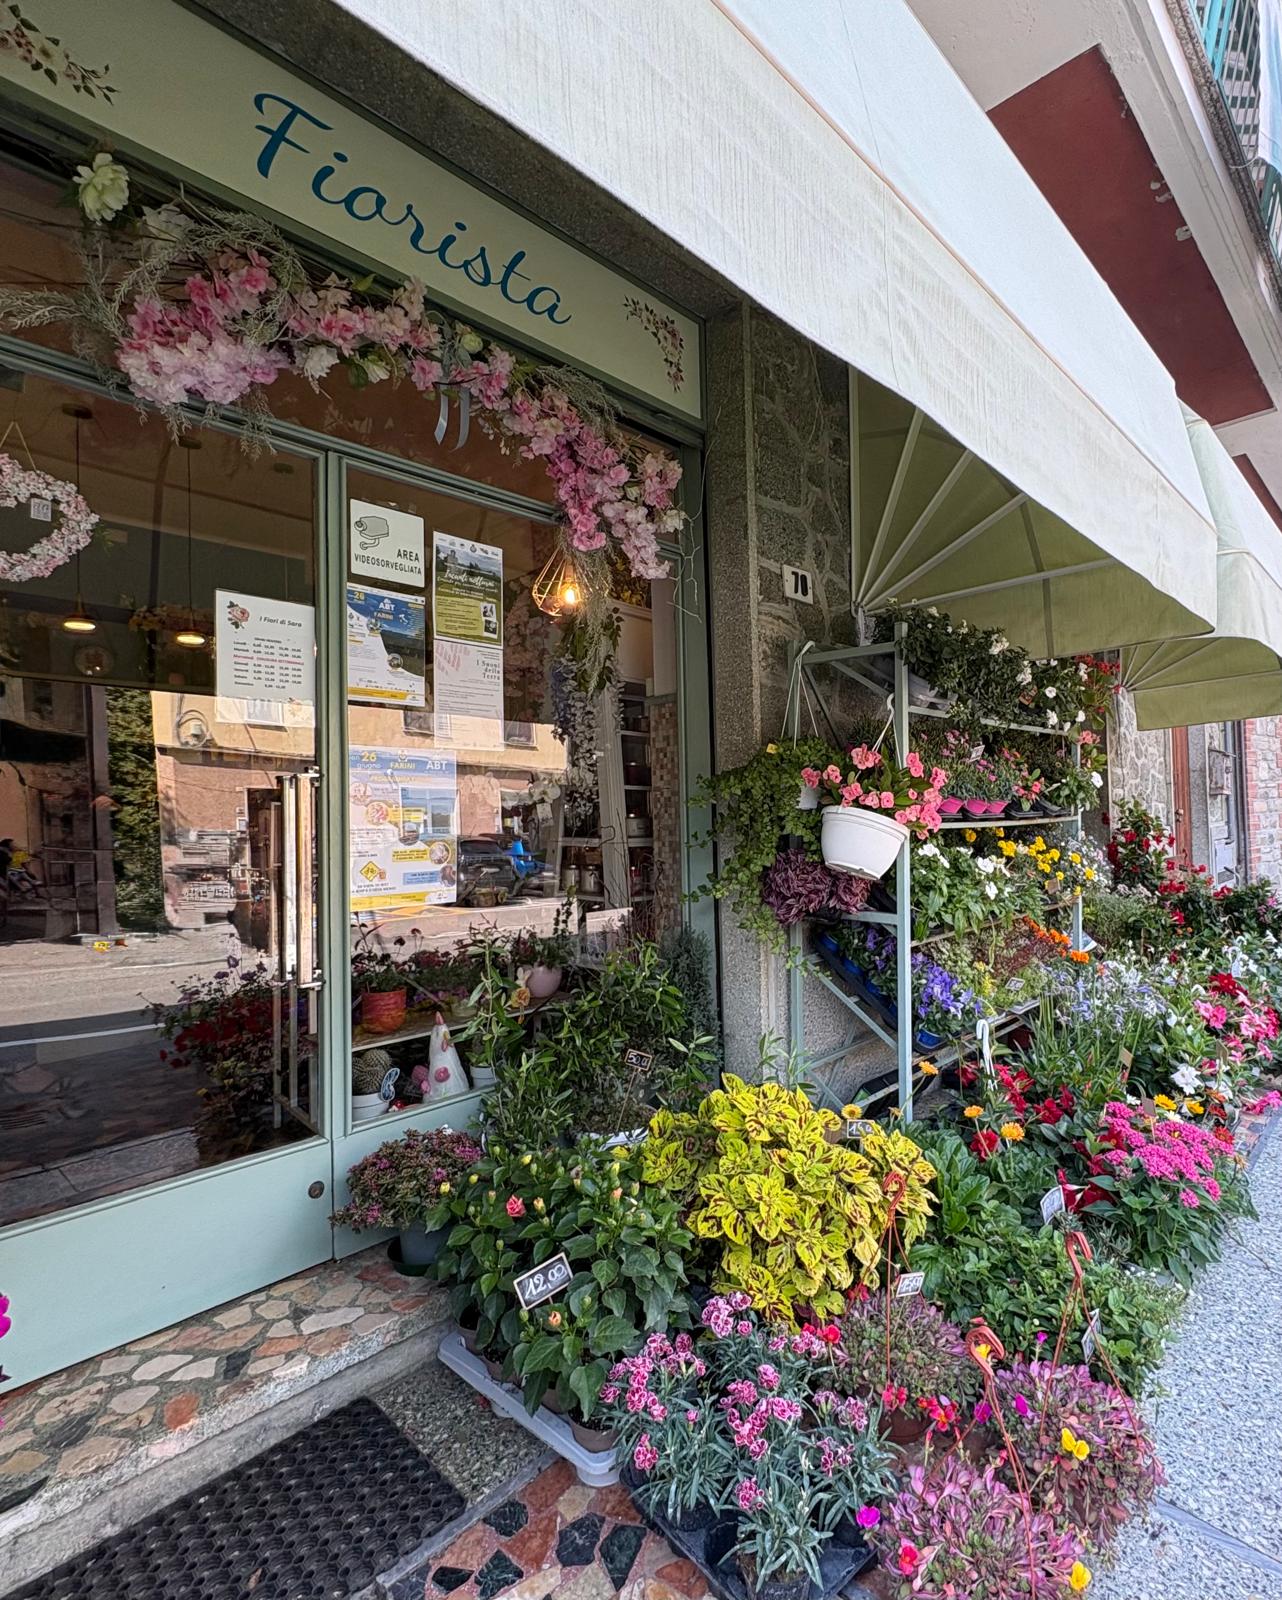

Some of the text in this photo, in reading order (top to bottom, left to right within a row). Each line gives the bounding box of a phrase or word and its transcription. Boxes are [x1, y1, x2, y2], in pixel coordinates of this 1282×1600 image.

[253, 92, 572, 324] Fiorista
[396, 548, 420, 564] AREA
[354, 553, 422, 575] VIDEOSORVEGLIATA
[378, 601, 396, 612] ABT
[263, 616, 279, 624] Fiori
[361, 751, 377, 762] 26
[390, 761, 416, 770] FARINI
[426, 760, 448, 770] ABT
[524, 1263, 568, 1300] 12,00
